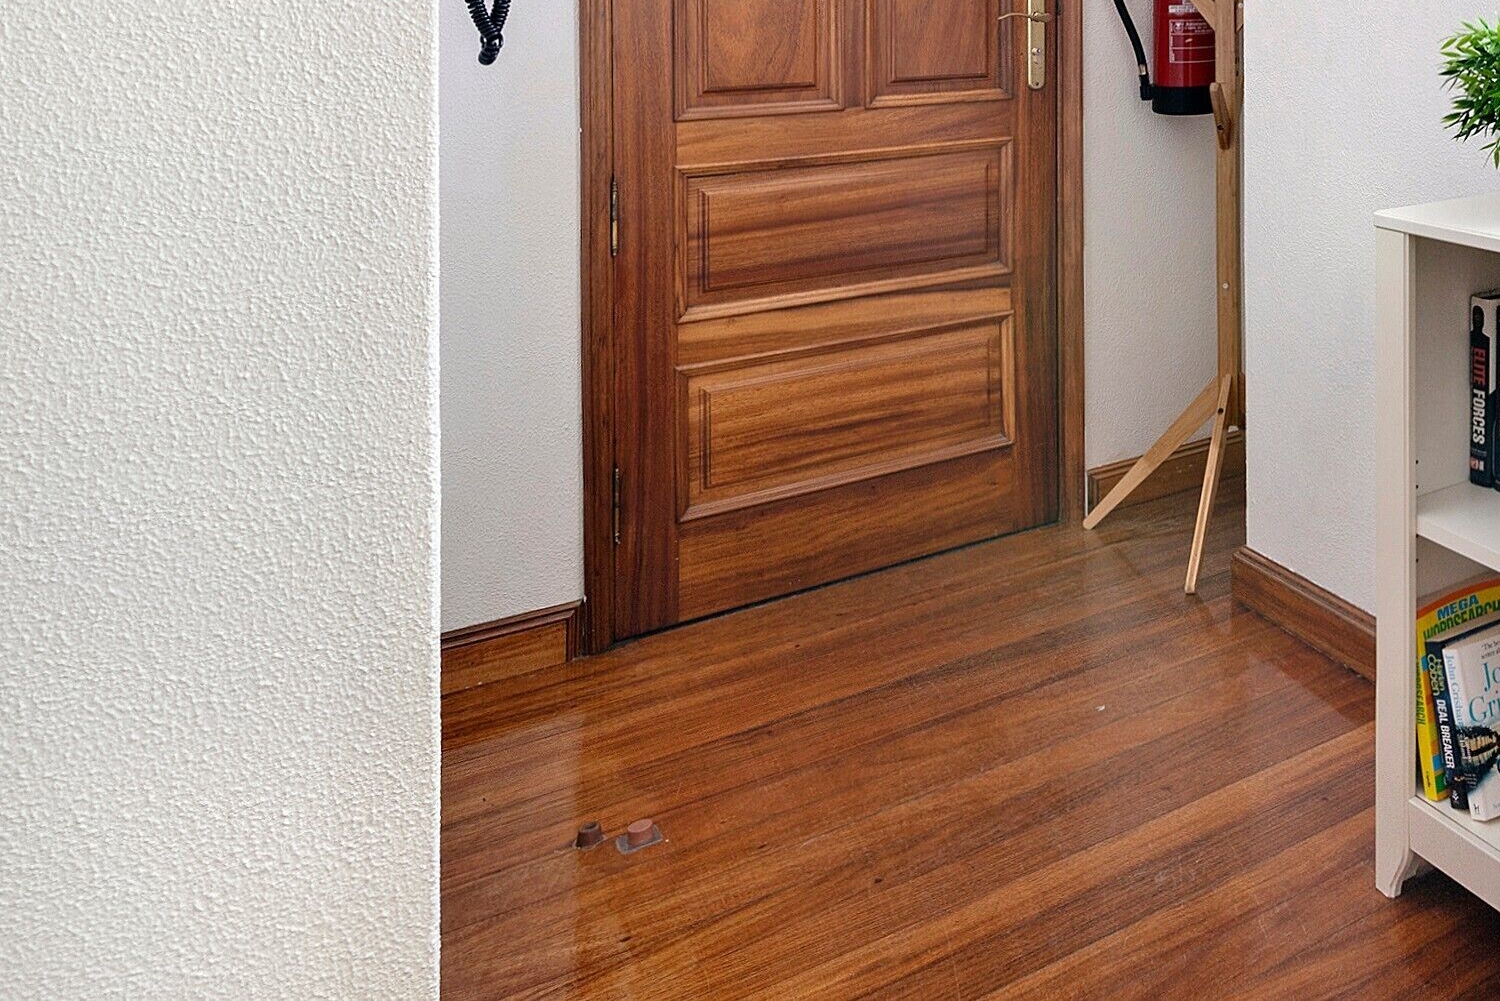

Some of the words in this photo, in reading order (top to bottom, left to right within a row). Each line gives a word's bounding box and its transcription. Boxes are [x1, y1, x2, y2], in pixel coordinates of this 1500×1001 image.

[1472, 346, 1487, 387] ELITE
[1472, 388, 1486, 445] FORCES
[1437, 594, 1479, 620] MEGA
[1426, 654, 1441, 697] Coben
[1445, 654, 1457, 683] John
[1436, 699, 1448, 725] DEAL
[1439, 725, 1456, 770] BREAKER
